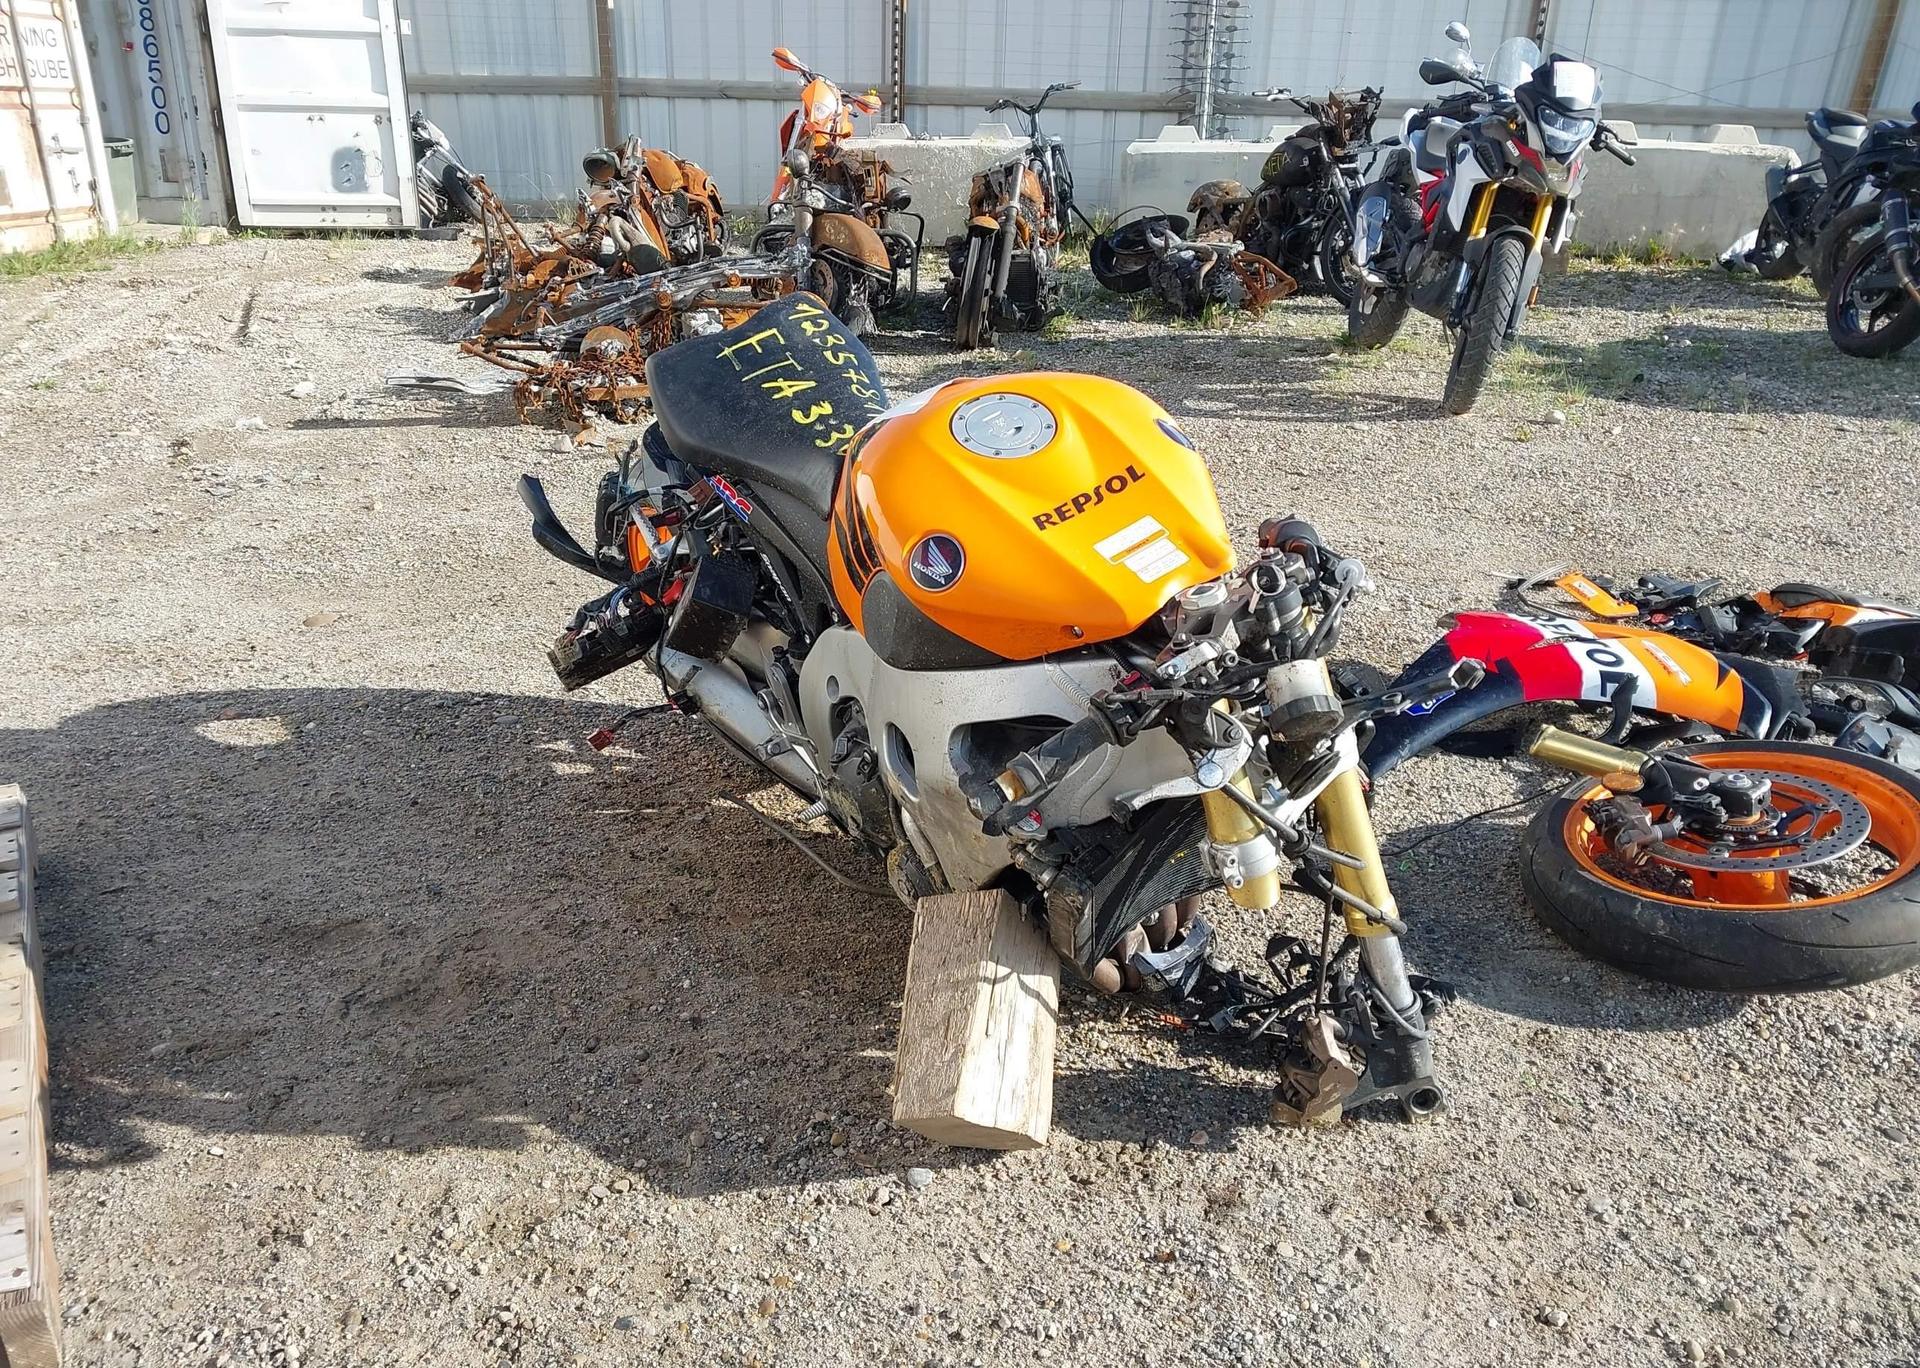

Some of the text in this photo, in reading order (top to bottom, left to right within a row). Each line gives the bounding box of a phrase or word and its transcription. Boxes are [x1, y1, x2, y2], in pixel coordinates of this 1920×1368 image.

[137, 0, 171, 135] 86500
[716, 328, 818, 399] ETA
[1032, 464, 1146, 532] REPSOL
[912, 561, 945, 585] HONDA
